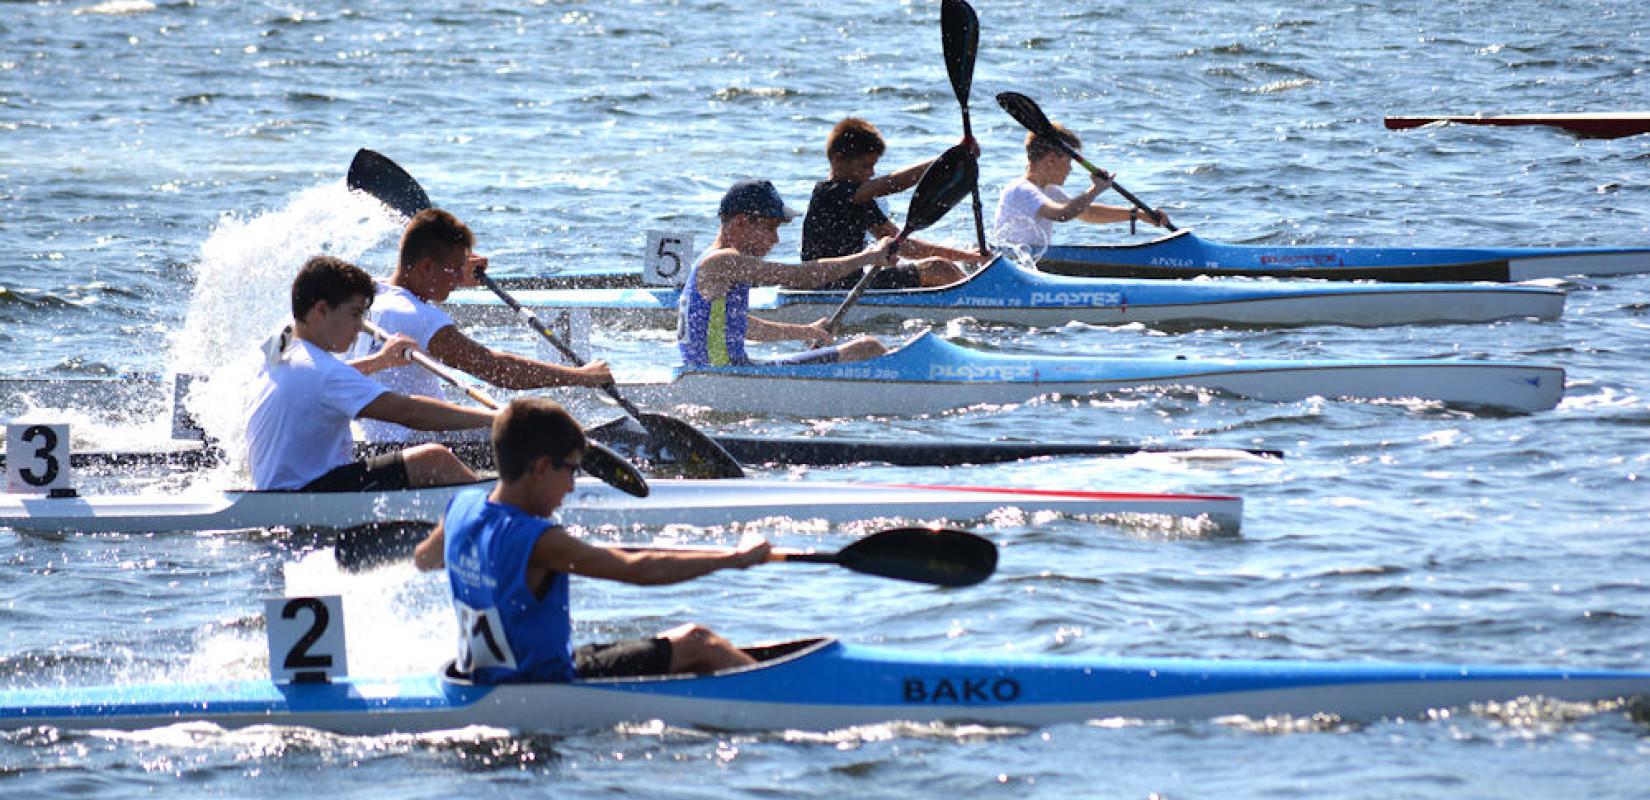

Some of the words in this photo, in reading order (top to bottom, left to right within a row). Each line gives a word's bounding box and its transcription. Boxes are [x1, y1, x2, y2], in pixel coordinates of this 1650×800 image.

[655, 237, 681, 279] 5
[1150, 256, 1194, 268] APOLLO
[955, 296, 1005, 307] ATHENA
[1030, 291, 1121, 307] PLASTEX
[928, 364, 1032, 381] PLASTEX
[19, 424, 60, 487] 3
[281, 597, 333, 670] 2
[904, 678, 1020, 702] BAKO
